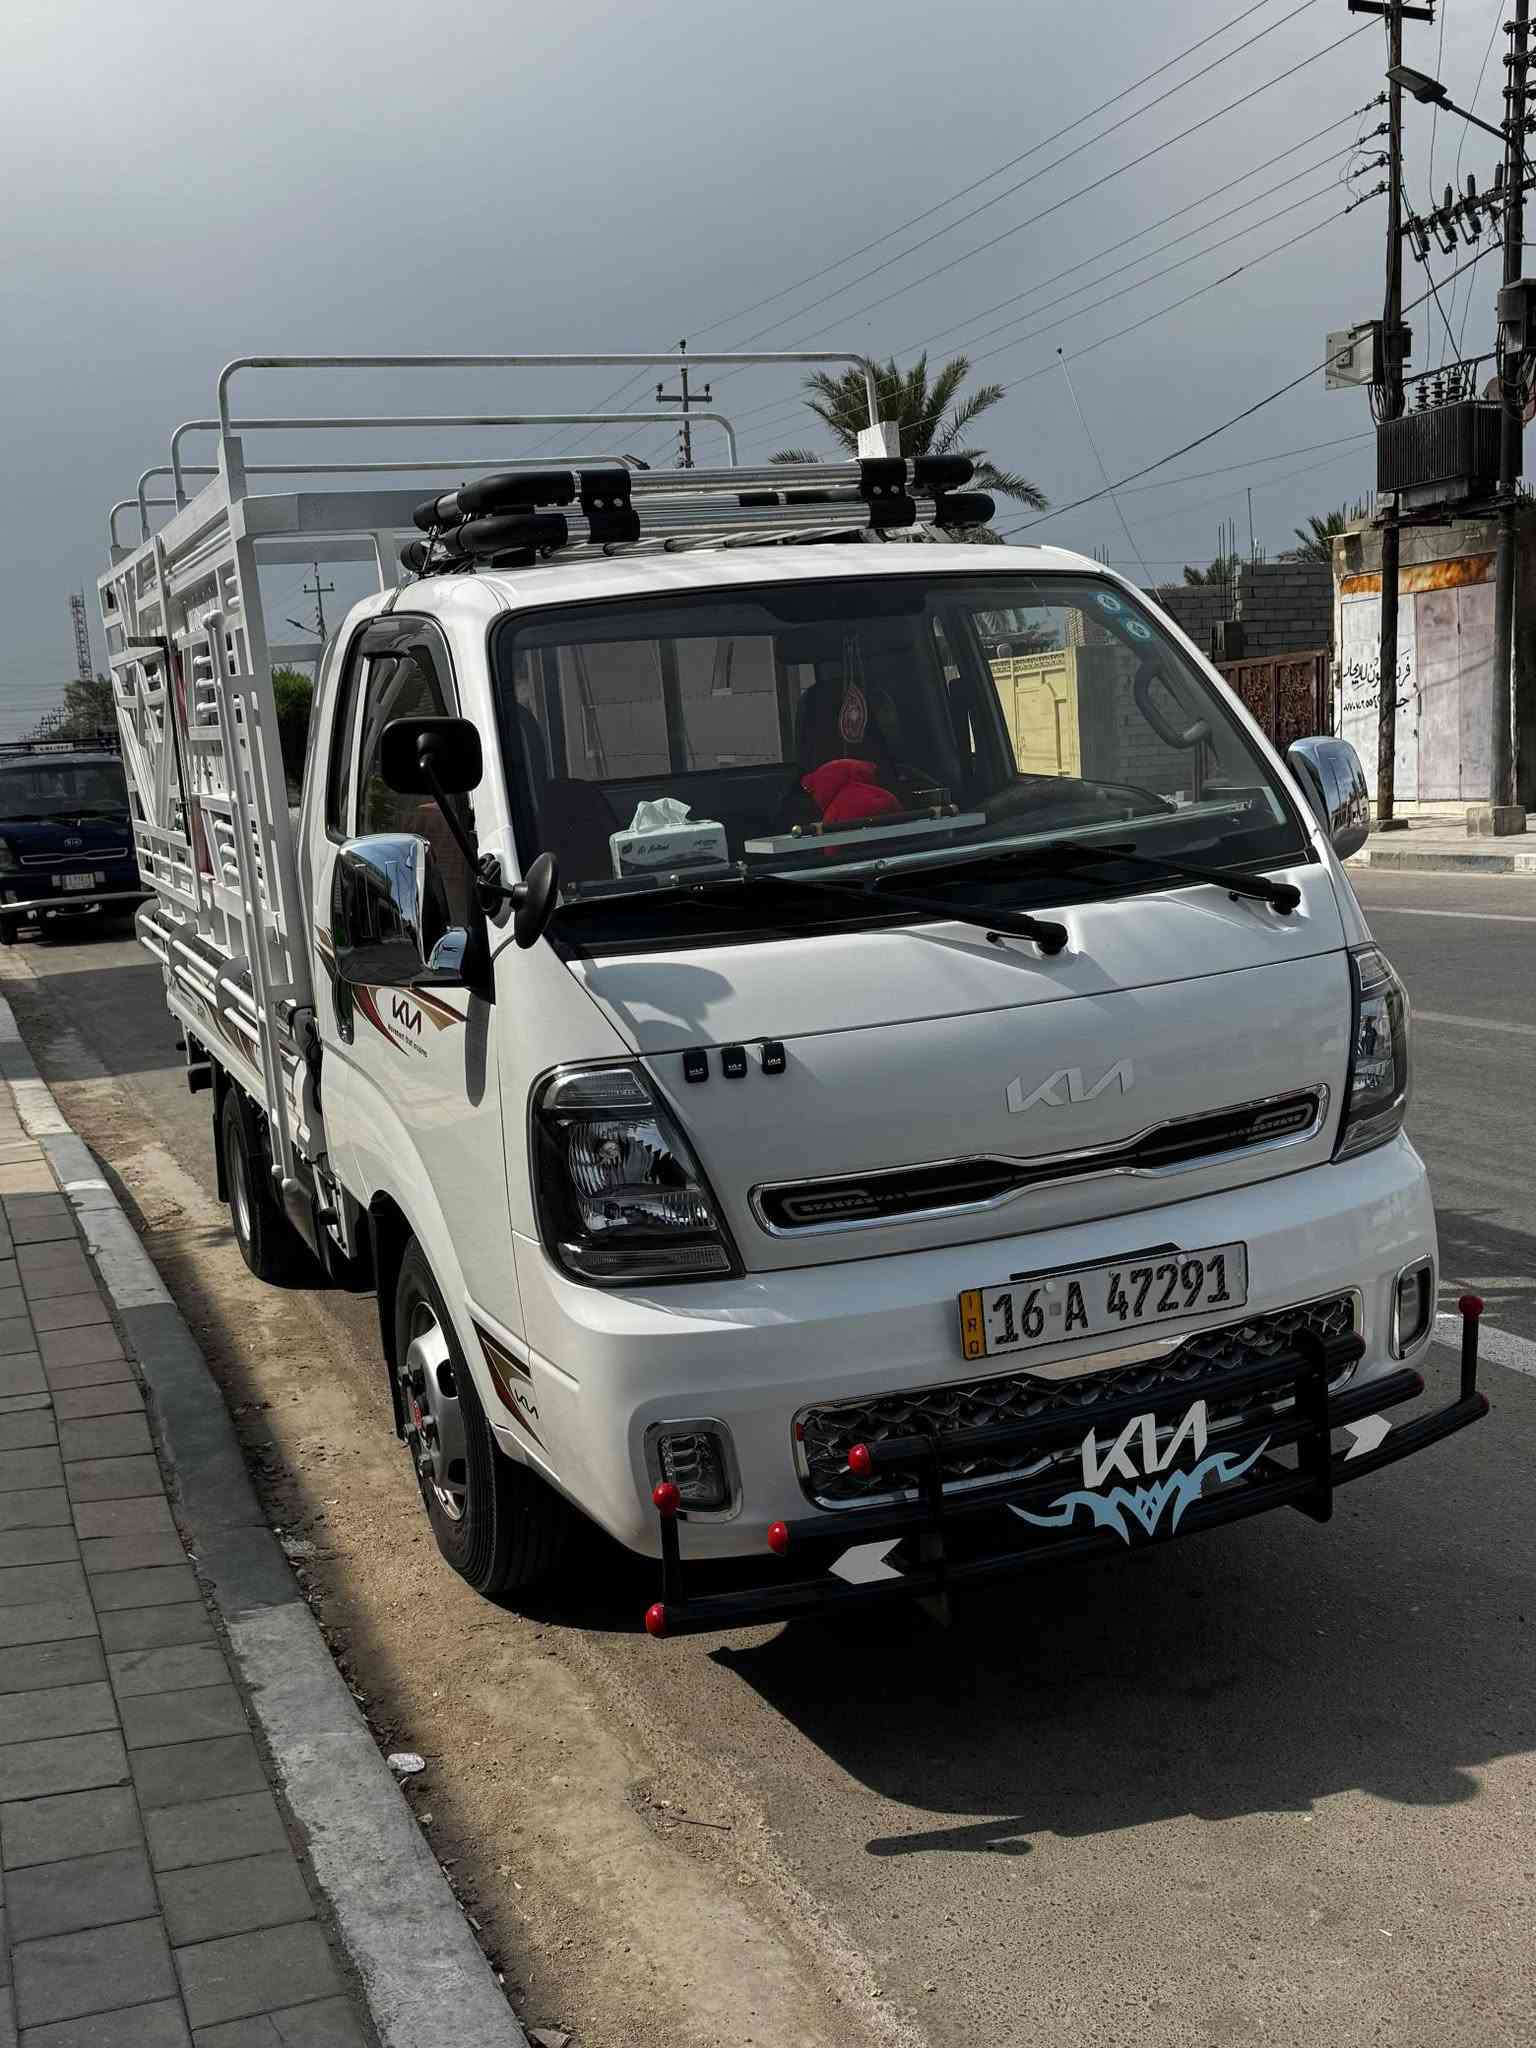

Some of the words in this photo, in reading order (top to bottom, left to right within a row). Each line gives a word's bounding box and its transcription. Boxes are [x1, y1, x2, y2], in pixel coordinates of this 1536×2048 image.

[391, 994, 422, 1036] KIA
[1005, 1057, 1134, 1113] KIA
[992, 1287, 1045, 1345] 16
[1064, 1280, 1089, 1331] A
[1107, 1253, 1231, 1321] 47291
[514, 1387, 540, 1420] KIA
[1081, 1399, 1208, 1489] KIA
